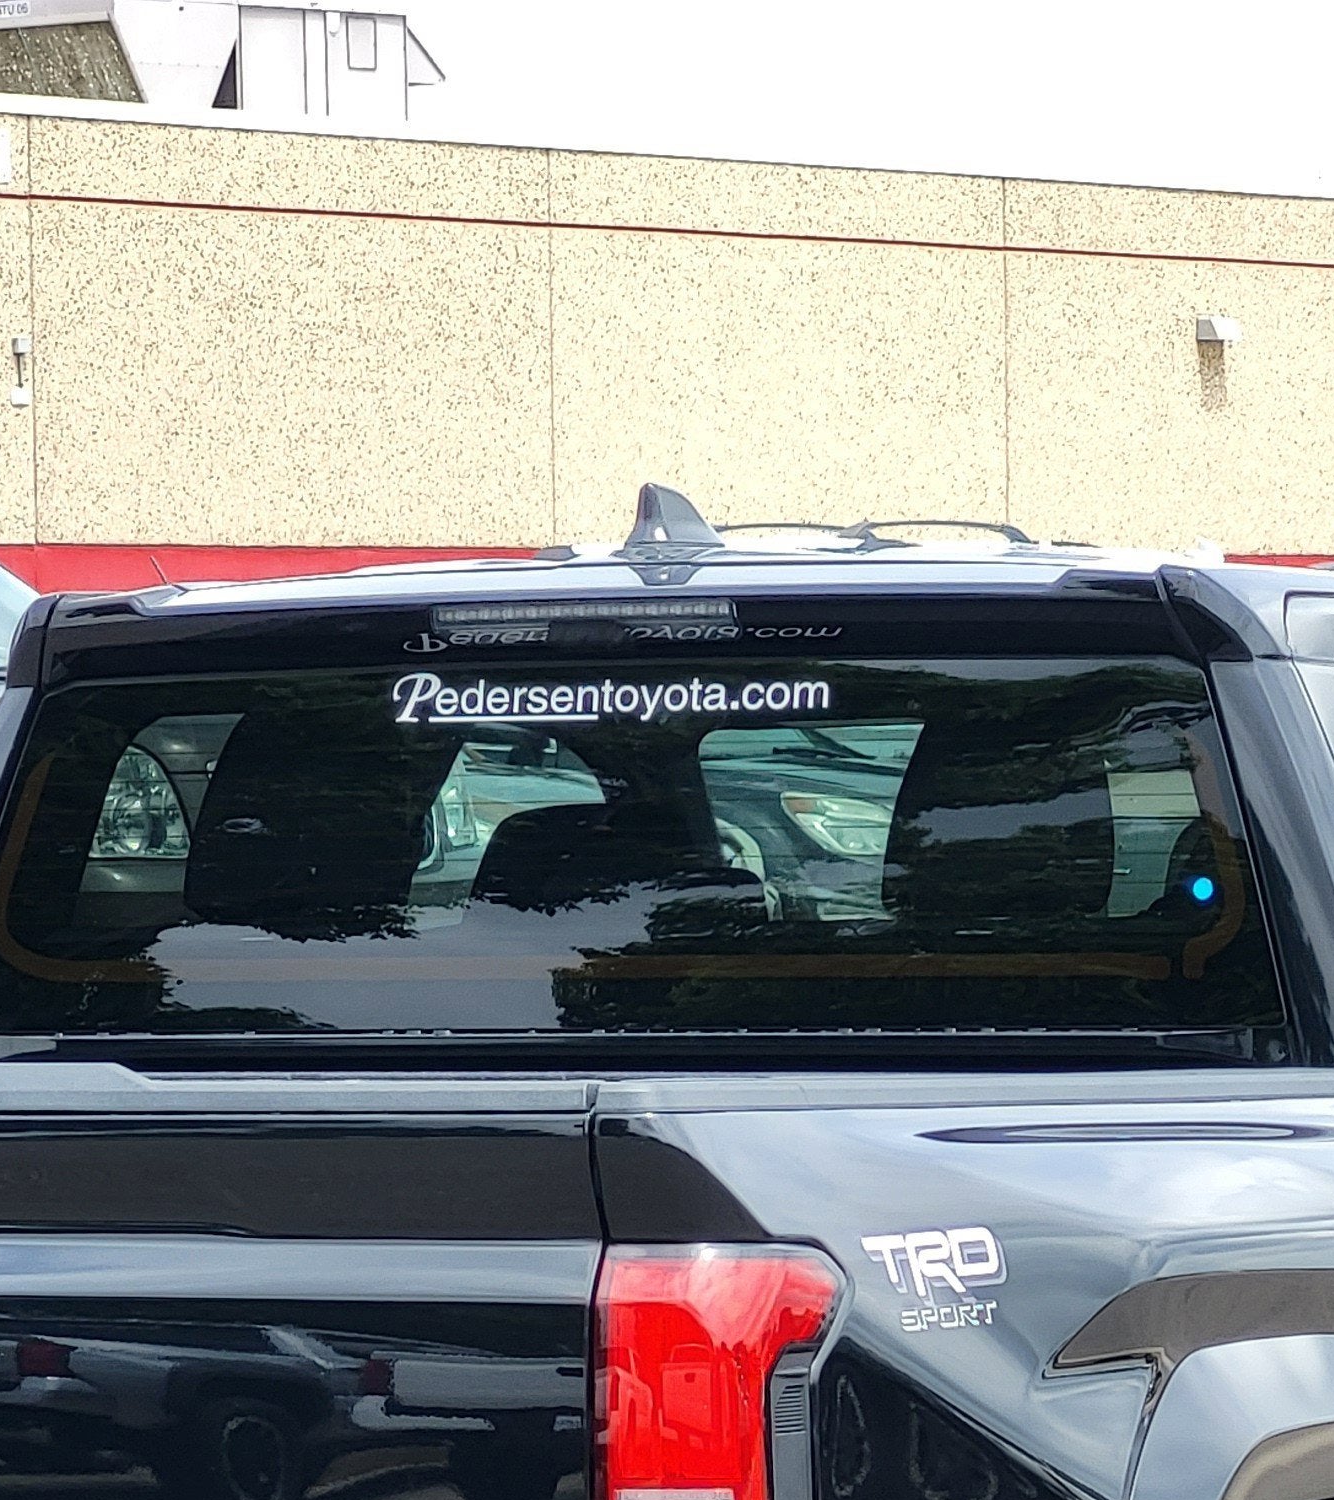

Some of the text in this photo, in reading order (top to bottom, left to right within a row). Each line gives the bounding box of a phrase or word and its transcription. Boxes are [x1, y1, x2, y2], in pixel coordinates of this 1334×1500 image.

[392, 672, 830, 723] Pedersentoyota.com
[860, 1226, 1004, 1298] TRD
[900, 1300, 999, 1332] SPORT
